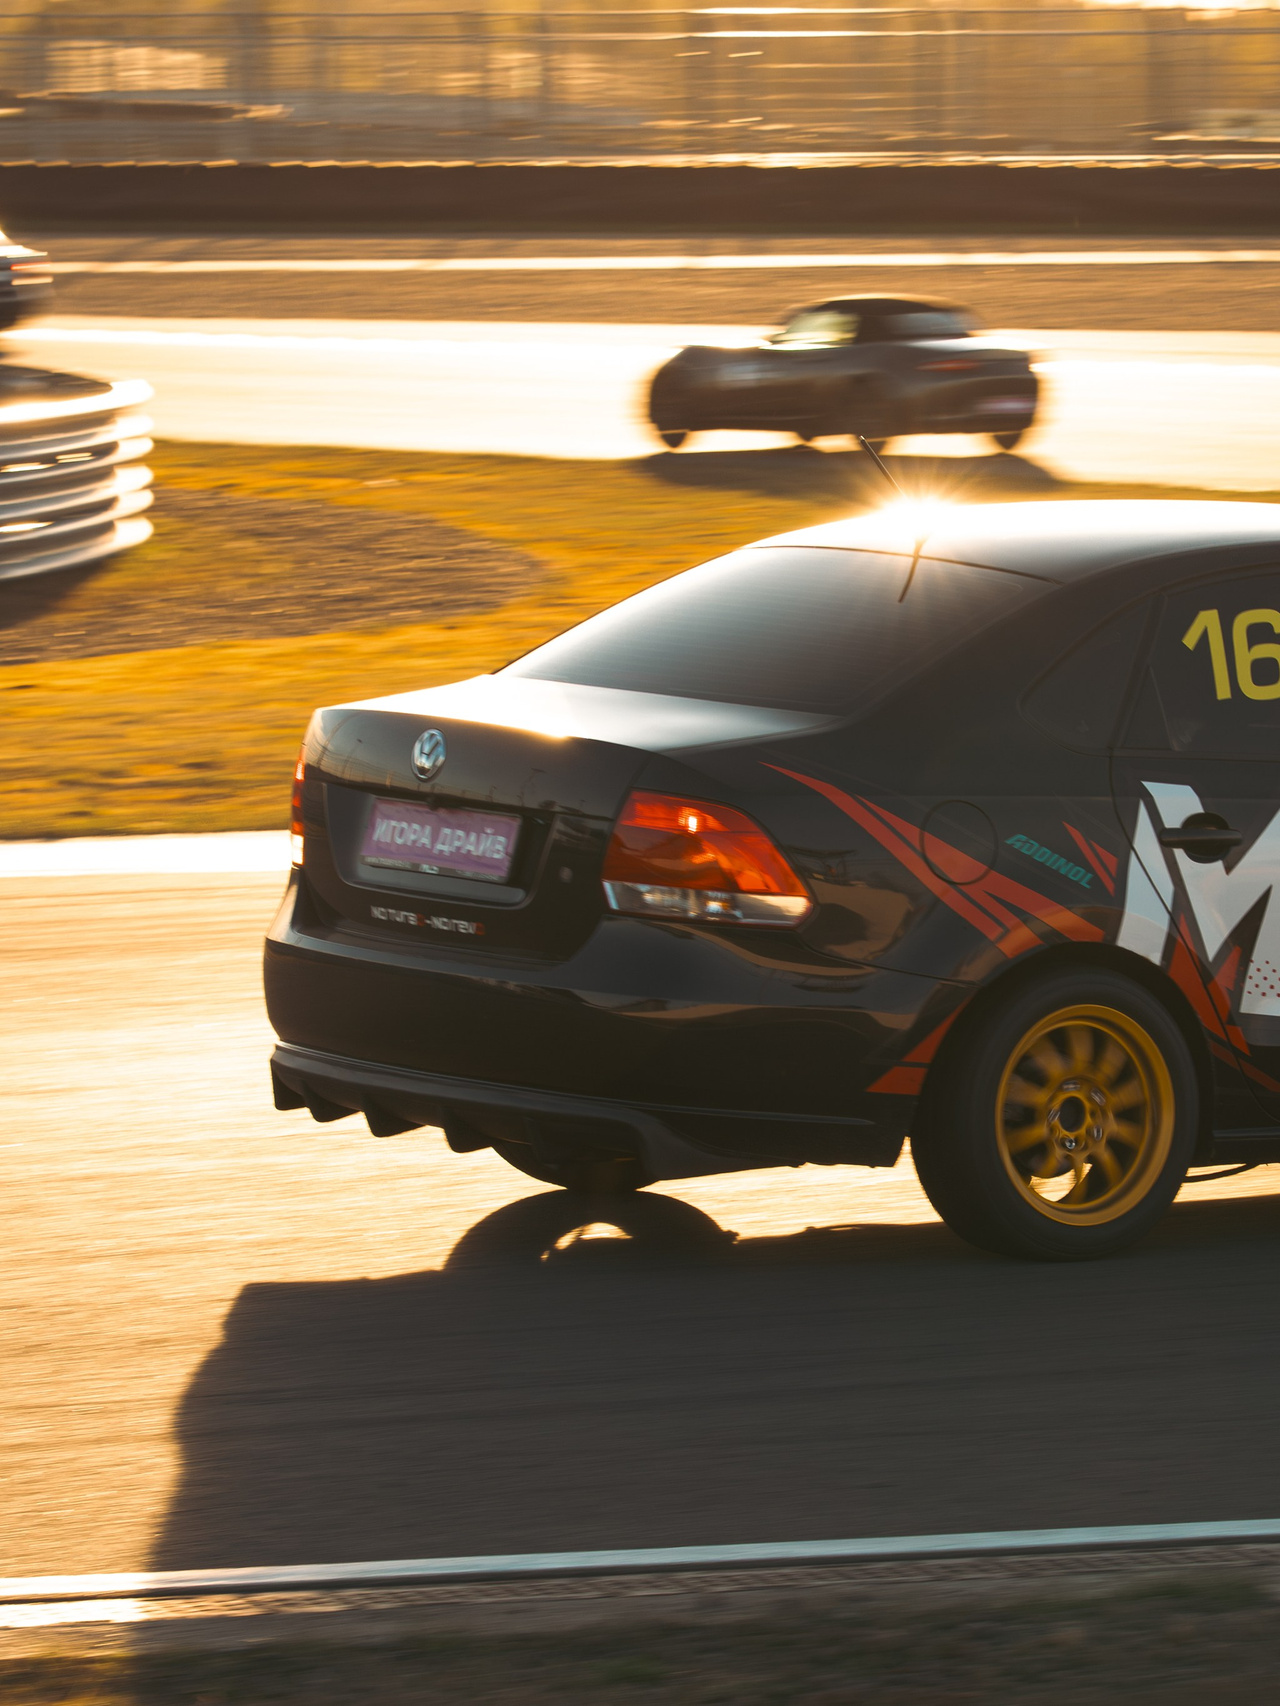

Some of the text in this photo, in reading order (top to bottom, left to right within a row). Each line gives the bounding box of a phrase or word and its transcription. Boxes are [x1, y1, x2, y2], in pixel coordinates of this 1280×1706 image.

[372, 818, 508, 859] ИГОРА ДРАЙВ
[1004, 833, 1095, 889] ADDINOL
